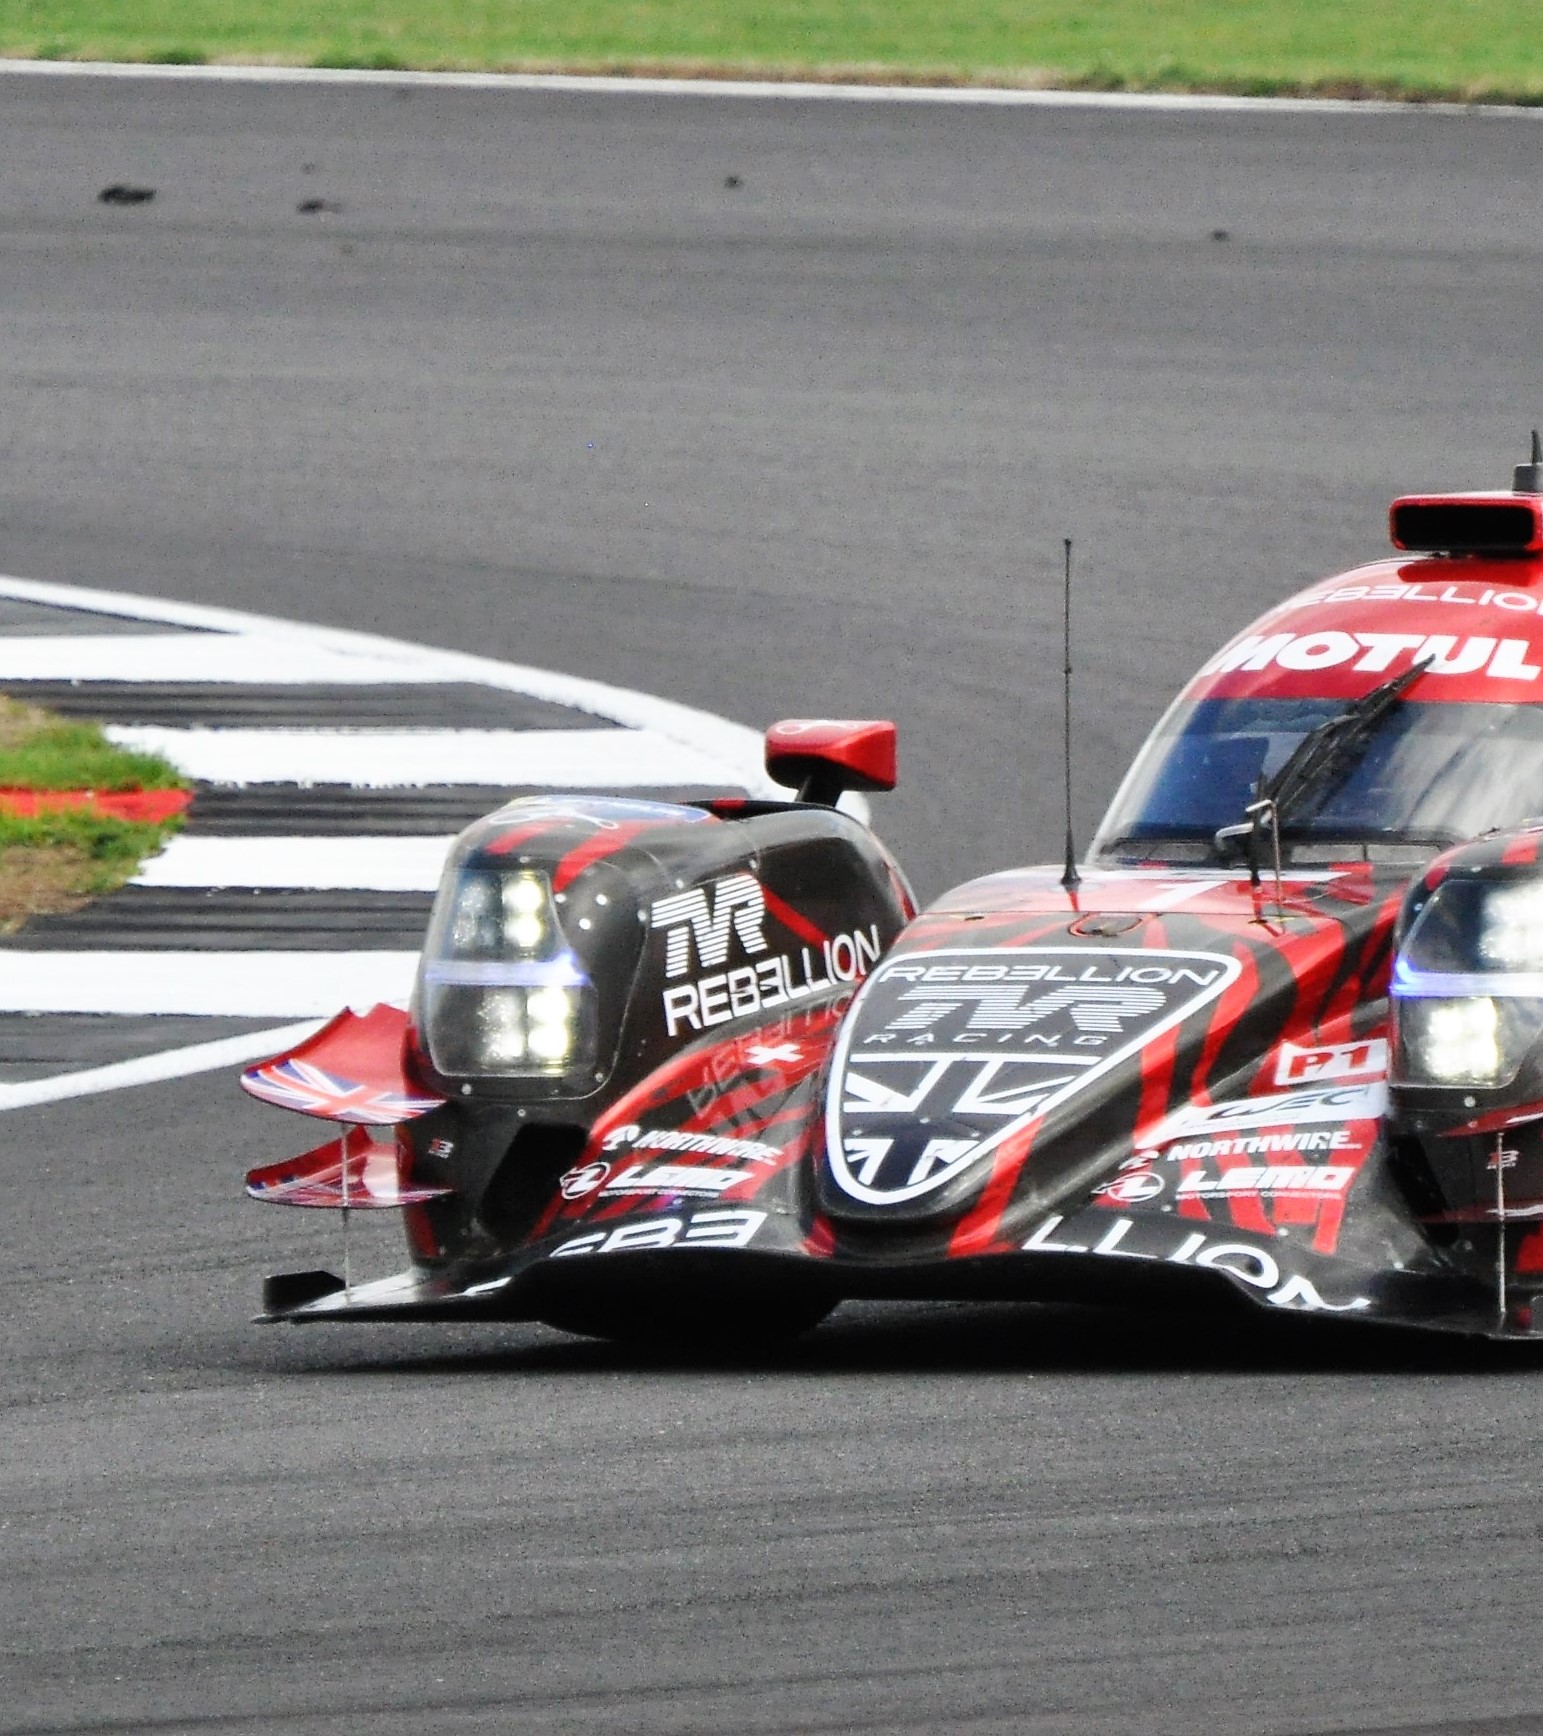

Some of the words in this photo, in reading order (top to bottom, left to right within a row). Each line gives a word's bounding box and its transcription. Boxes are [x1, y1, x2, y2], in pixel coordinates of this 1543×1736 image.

[1202, 631, 1542, 681] MOTUL
[651, 874, 768, 979] TVR
[662, 924, 882, 1037] REBELLION
[879, 964, 1222, 985] REBELLION
[885, 985, 1167, 1033] TVR
[863, 1032, 1107, 1047] RACING
[1287, 1048, 1370, 1079] P1
[1167, 1131, 1353, 1162] NORTHWIRE
[605, 1166, 755, 1190] LEMO
[1176, 1166, 1357, 1193] LEMO
